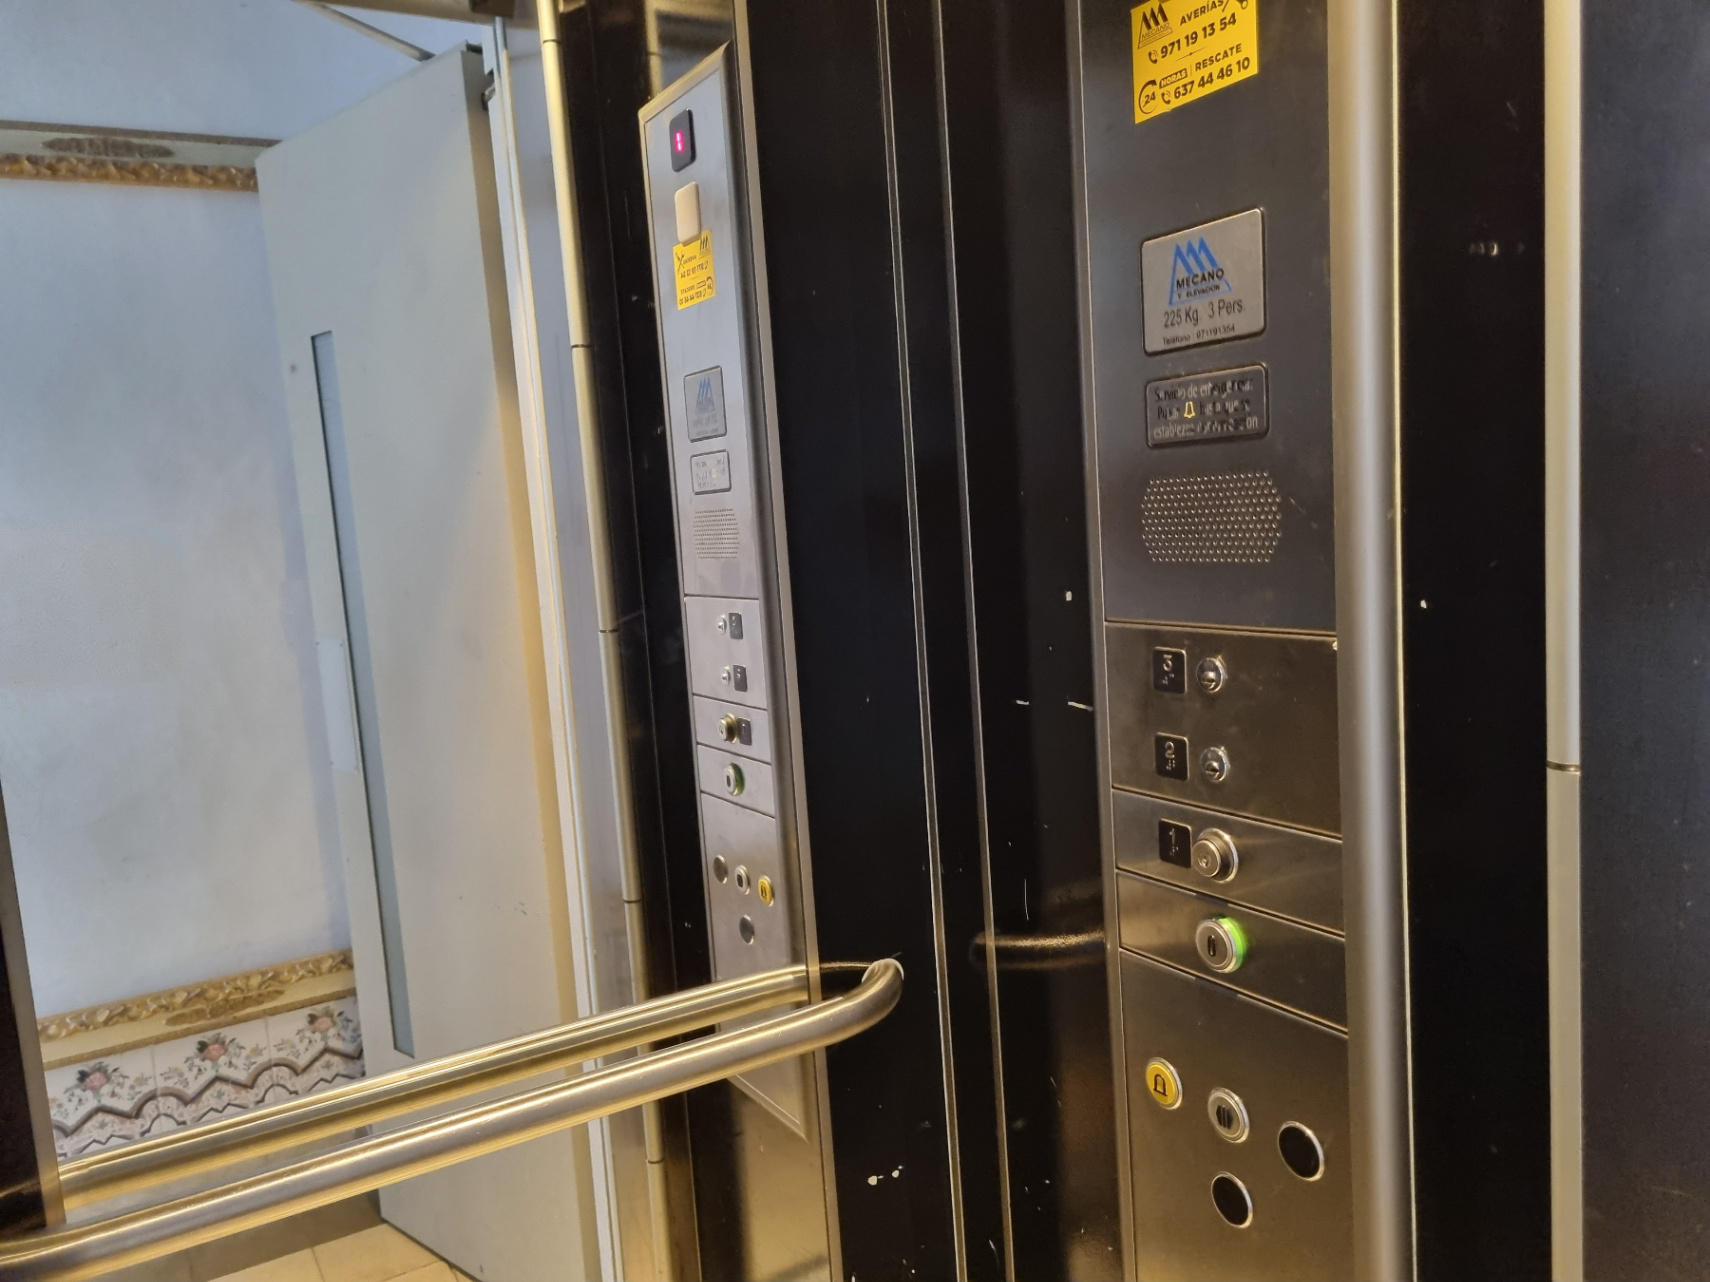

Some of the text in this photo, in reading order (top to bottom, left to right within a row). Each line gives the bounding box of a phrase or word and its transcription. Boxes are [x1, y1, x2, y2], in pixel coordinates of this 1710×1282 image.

[1179, 0, 1224, 26] AVERÍAS
[1160, 38, 1182, 60] 971
[1184, 31, 1199, 49] 19
[1202, 22, 1217, 40] 13
[1219, 12, 1237, 32] 54
[1160, 43, 1243, 88] HORAS RESCATE
[1173, 56, 1251, 100] 637 44 46 10
[1144, 90, 1157, 108] 24
[1176, 268, 1225, 290] MECANO
[1177, 292, 1183, 300] Y
[1163, 310, 1183, 330] 225
[1208, 301, 1215, 319] 3
[1187, 382, 1199, 399] de
[1165, 740, 1175, 759] 2
[1168, 827, 1176, 845] 1
